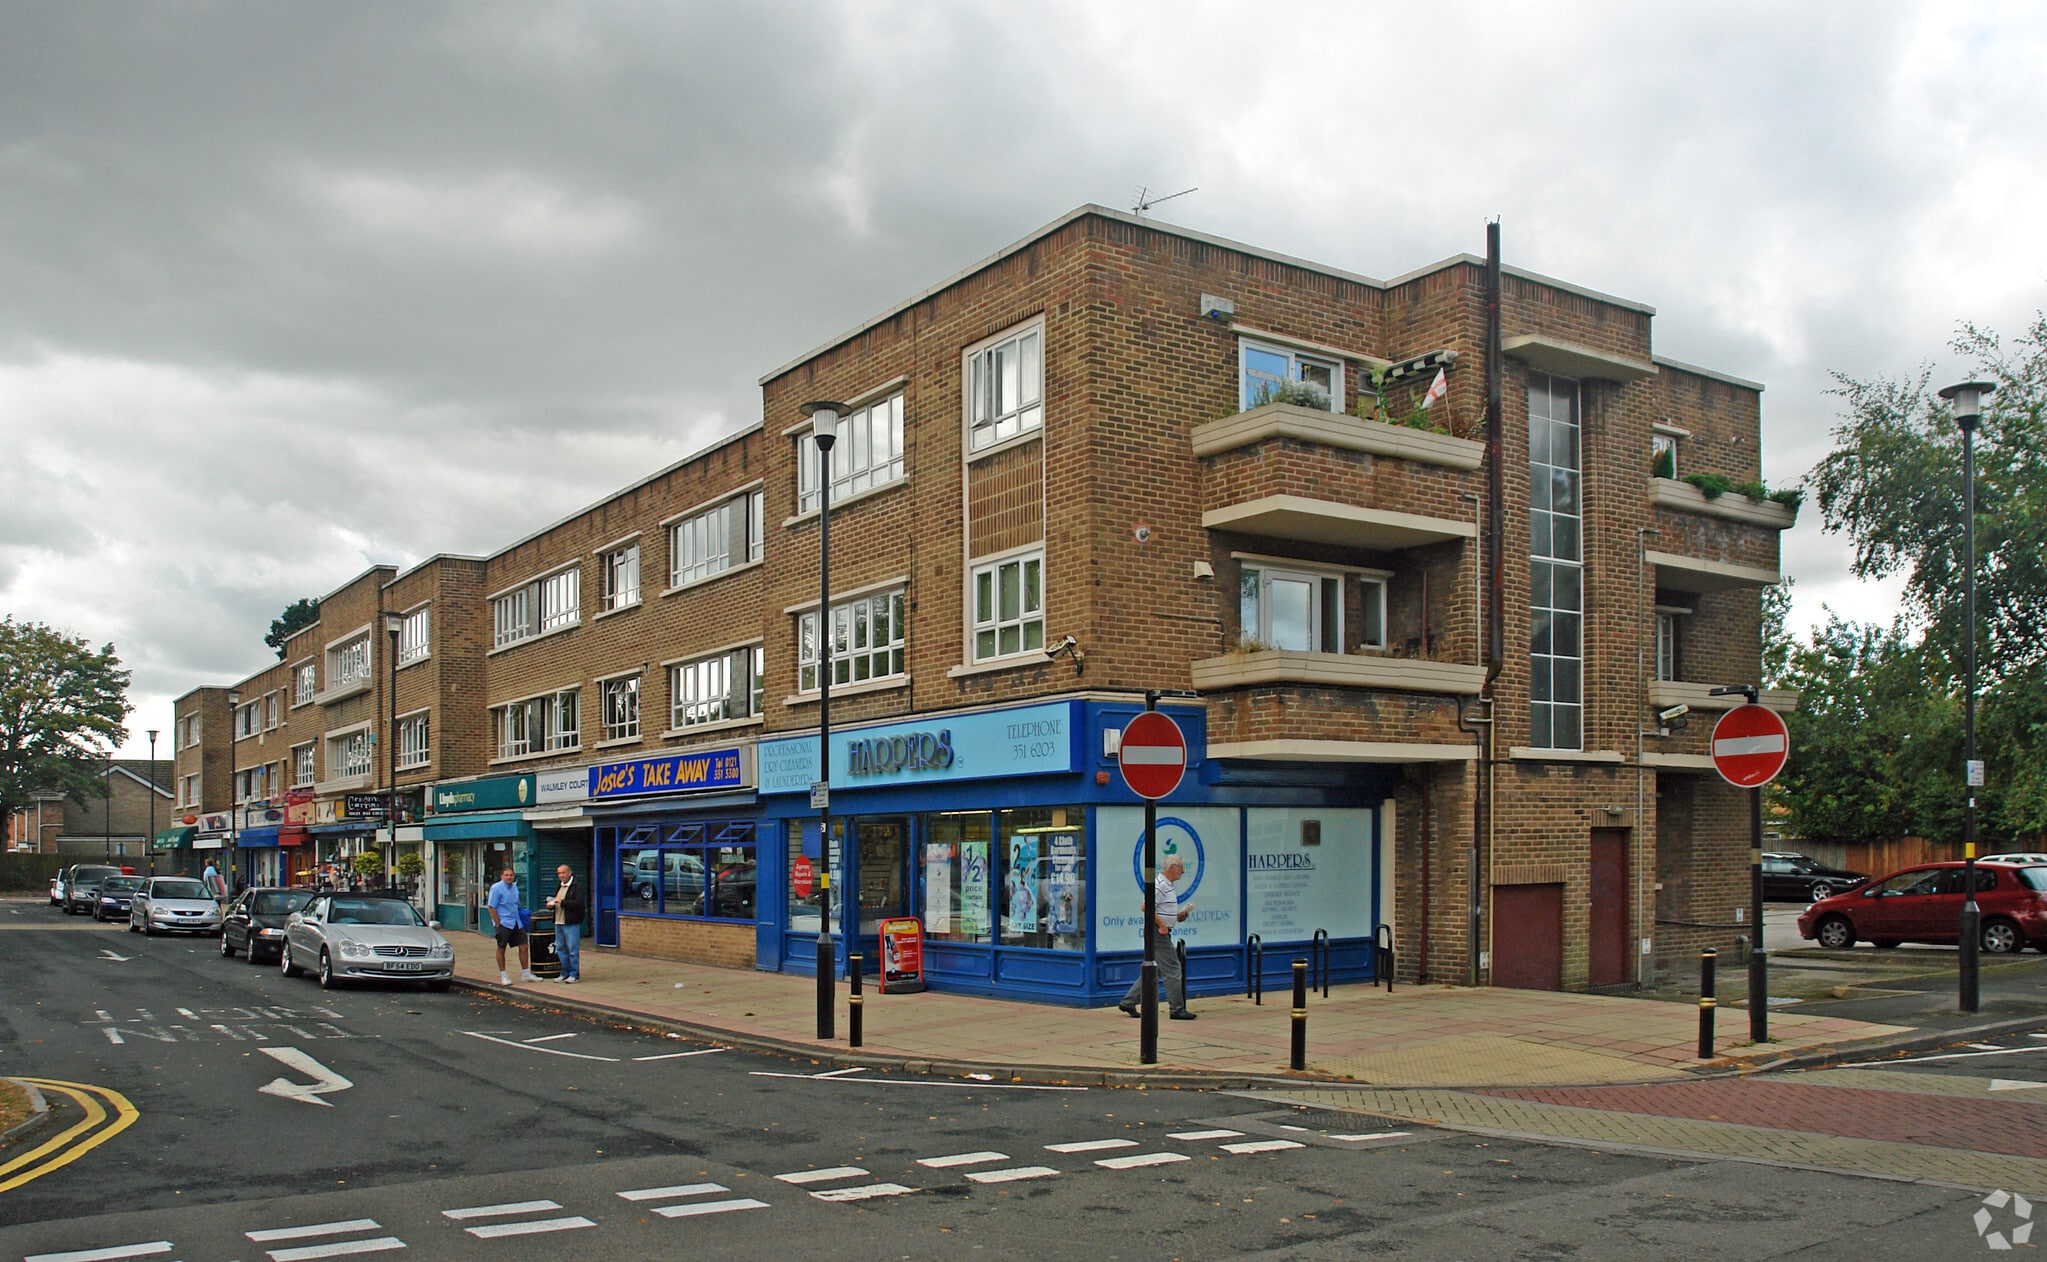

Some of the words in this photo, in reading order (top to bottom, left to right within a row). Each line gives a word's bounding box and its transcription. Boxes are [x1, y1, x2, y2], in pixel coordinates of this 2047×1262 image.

[1007, 719, 1061, 740] TELEPHONE
[847, 727, 954, 776] HARPERS
[1013, 744, 1028, 760] 351
[1030, 741, 1056, 758] 6203
[540, 783, 567, 792] WALMLEY
[569, 779, 588, 790] COURT
[594, 763, 635, 796] Josie's
[643, 763, 672, 787] TAKE
[674, 758, 710, 785] AWAY
[1013, 843, 1020, 869] 2
[1249, 854, 1311, 869] HARPERS
[965, 885, 983, 893] price
[1103, 916, 1124, 927] Only
